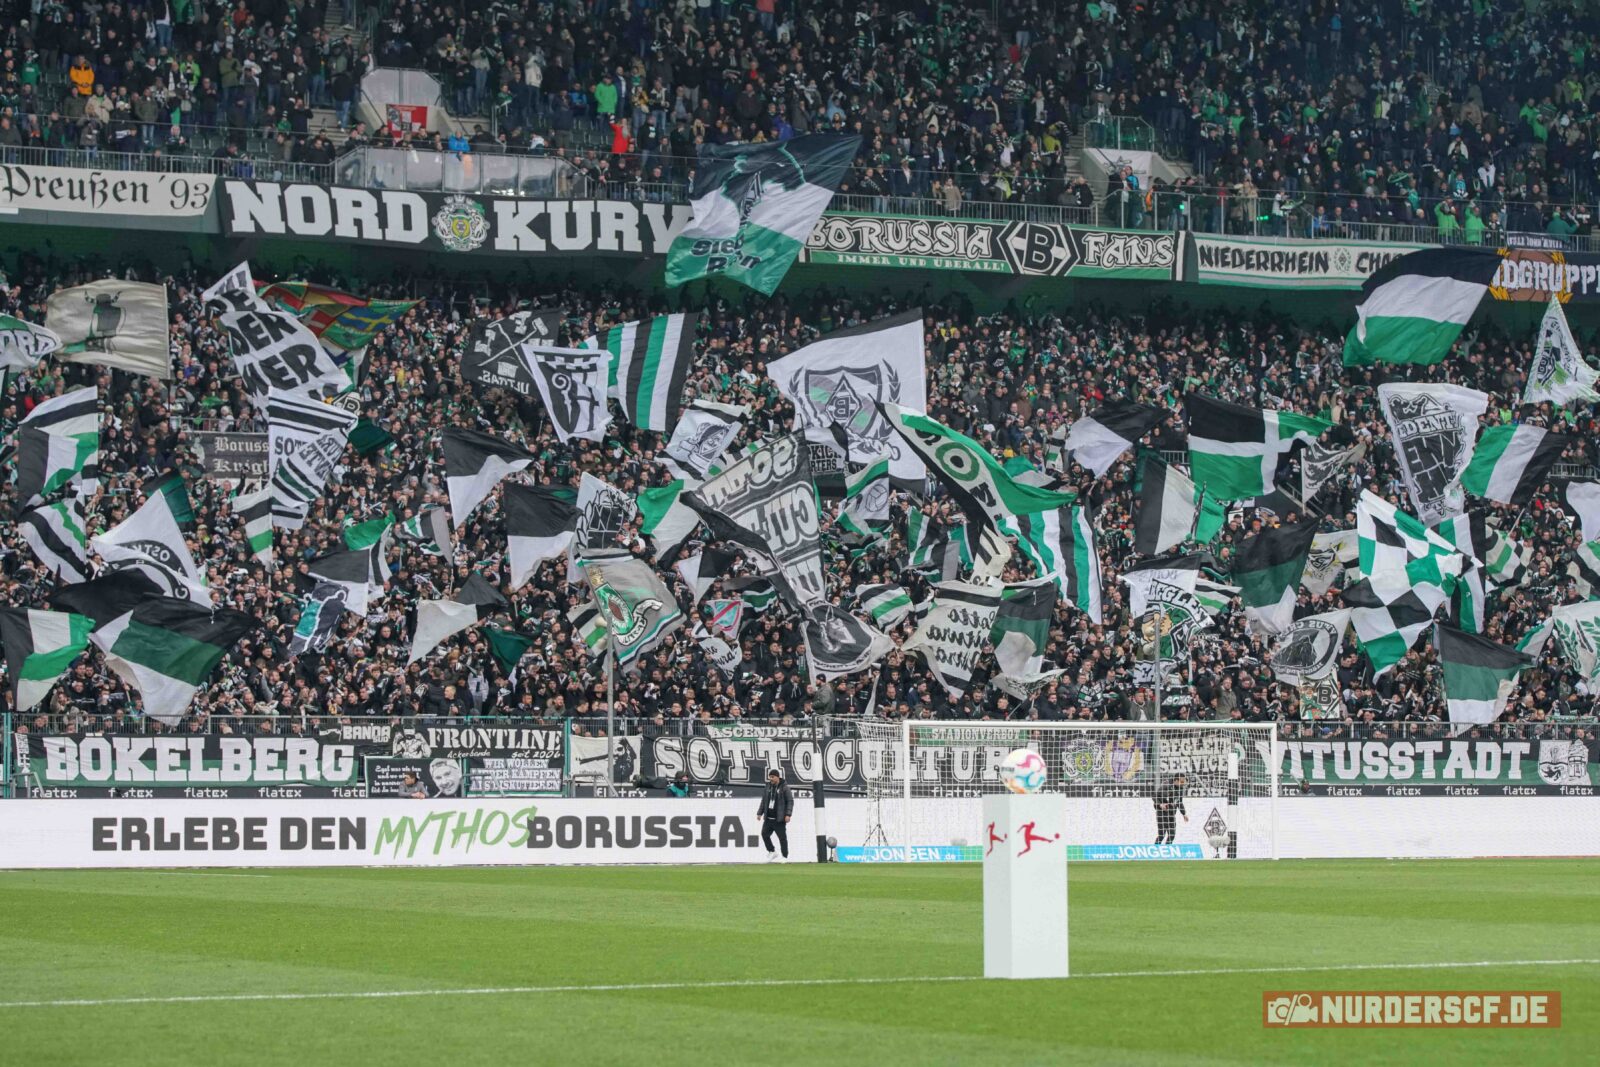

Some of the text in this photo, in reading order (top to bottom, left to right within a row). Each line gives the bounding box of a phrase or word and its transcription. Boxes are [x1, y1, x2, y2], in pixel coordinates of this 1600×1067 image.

[225, 181, 694, 253] NORD KURV
[807, 218, 992, 261] BORUSSIA
[1082, 233, 1175, 269] FANS
[837, 253, 891, 265] IMMER
[899, 256, 927, 267] UND
[1198, 245, 1330, 274] NIEDERRHEIN
[214, 436, 270, 452] Boruss
[343, 725, 391, 740] BANDA
[711, 725, 824, 739] ASCENDENTE
[427, 728, 562, 751] FRONTLINE
[43, 736, 354, 782] BOKELBERG
[507, 758, 549, 769] WOLLEN
[653, 737, 1041, 784] SOTTOCULTUR
[1254, 740, 1531, 780] VITUSSTADT
[31, 787, 77, 798] fatex
[184, 787, 228, 798] flatex
[258, 787, 303, 798] flatex
[331, 787, 366, 798] flate
[1327, 786, 1362, 796] flatex
[1386, 786, 1421, 796] flatex
[1445, 785, 1479, 796] flatex
[1502, 785, 1537, 795] flatex
[1560, 784, 1594, 795] flatex
[93, 806, 759, 858] ERLEBE DEN MYTHOS BORUSSIA.
[1117, 846, 1181, 859] JONGEN
